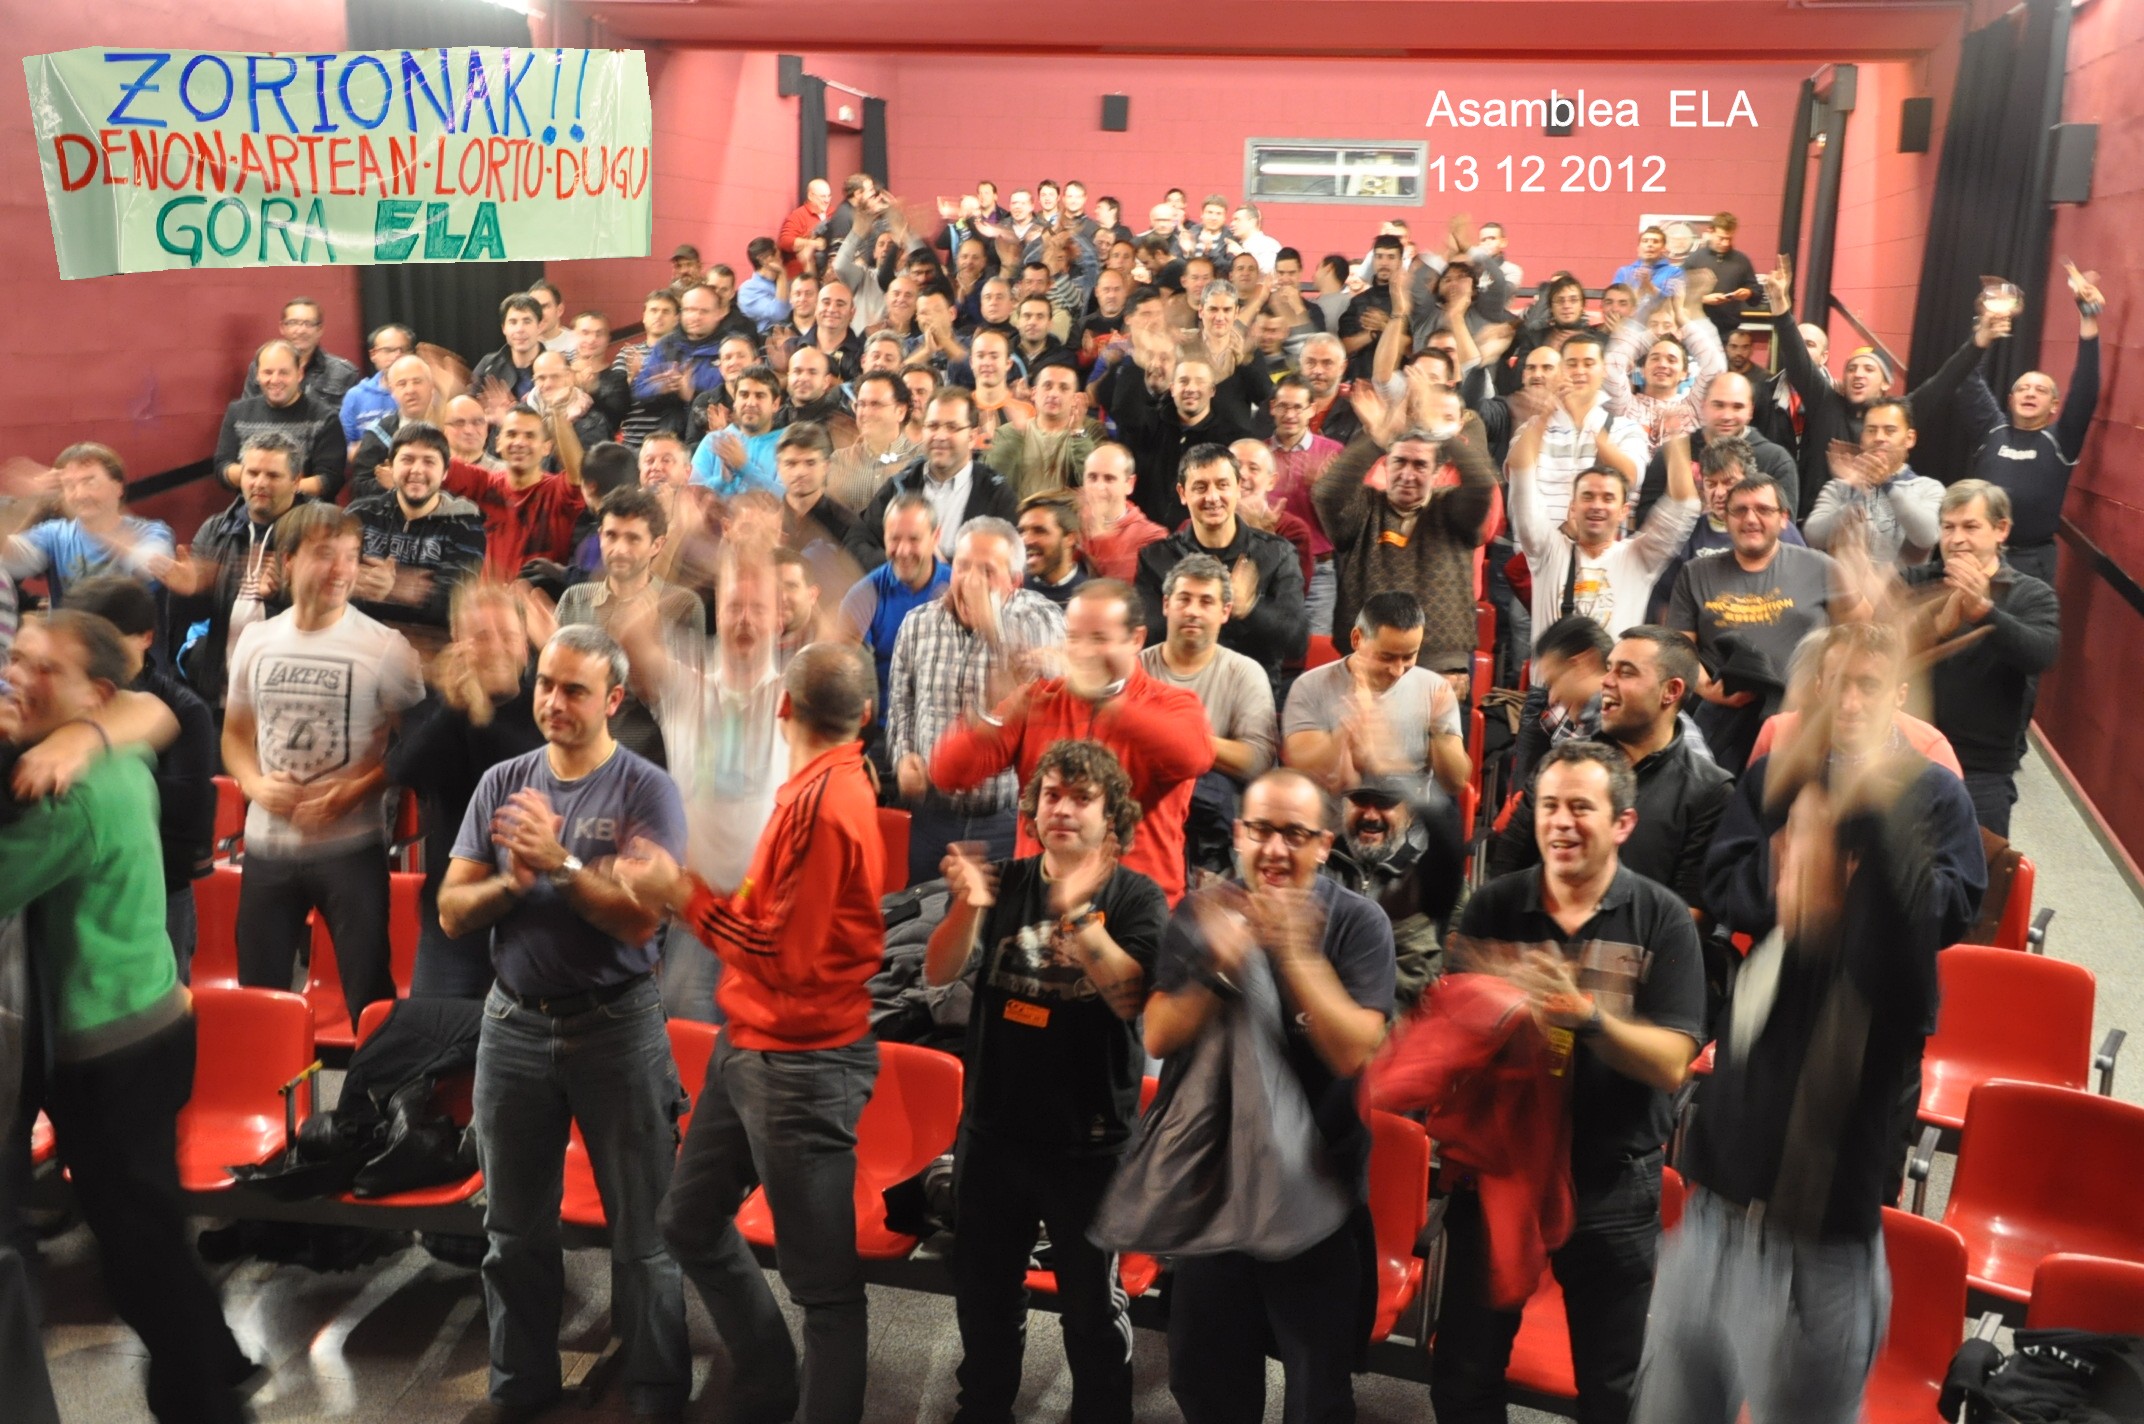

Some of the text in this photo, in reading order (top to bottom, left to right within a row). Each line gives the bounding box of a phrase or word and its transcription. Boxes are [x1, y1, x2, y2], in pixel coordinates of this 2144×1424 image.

[103, 47, 590, 146] ZORIONAK!!
[156, 194, 507, 266] GORA ELA
[264, 660, 341, 690] LAKERS
